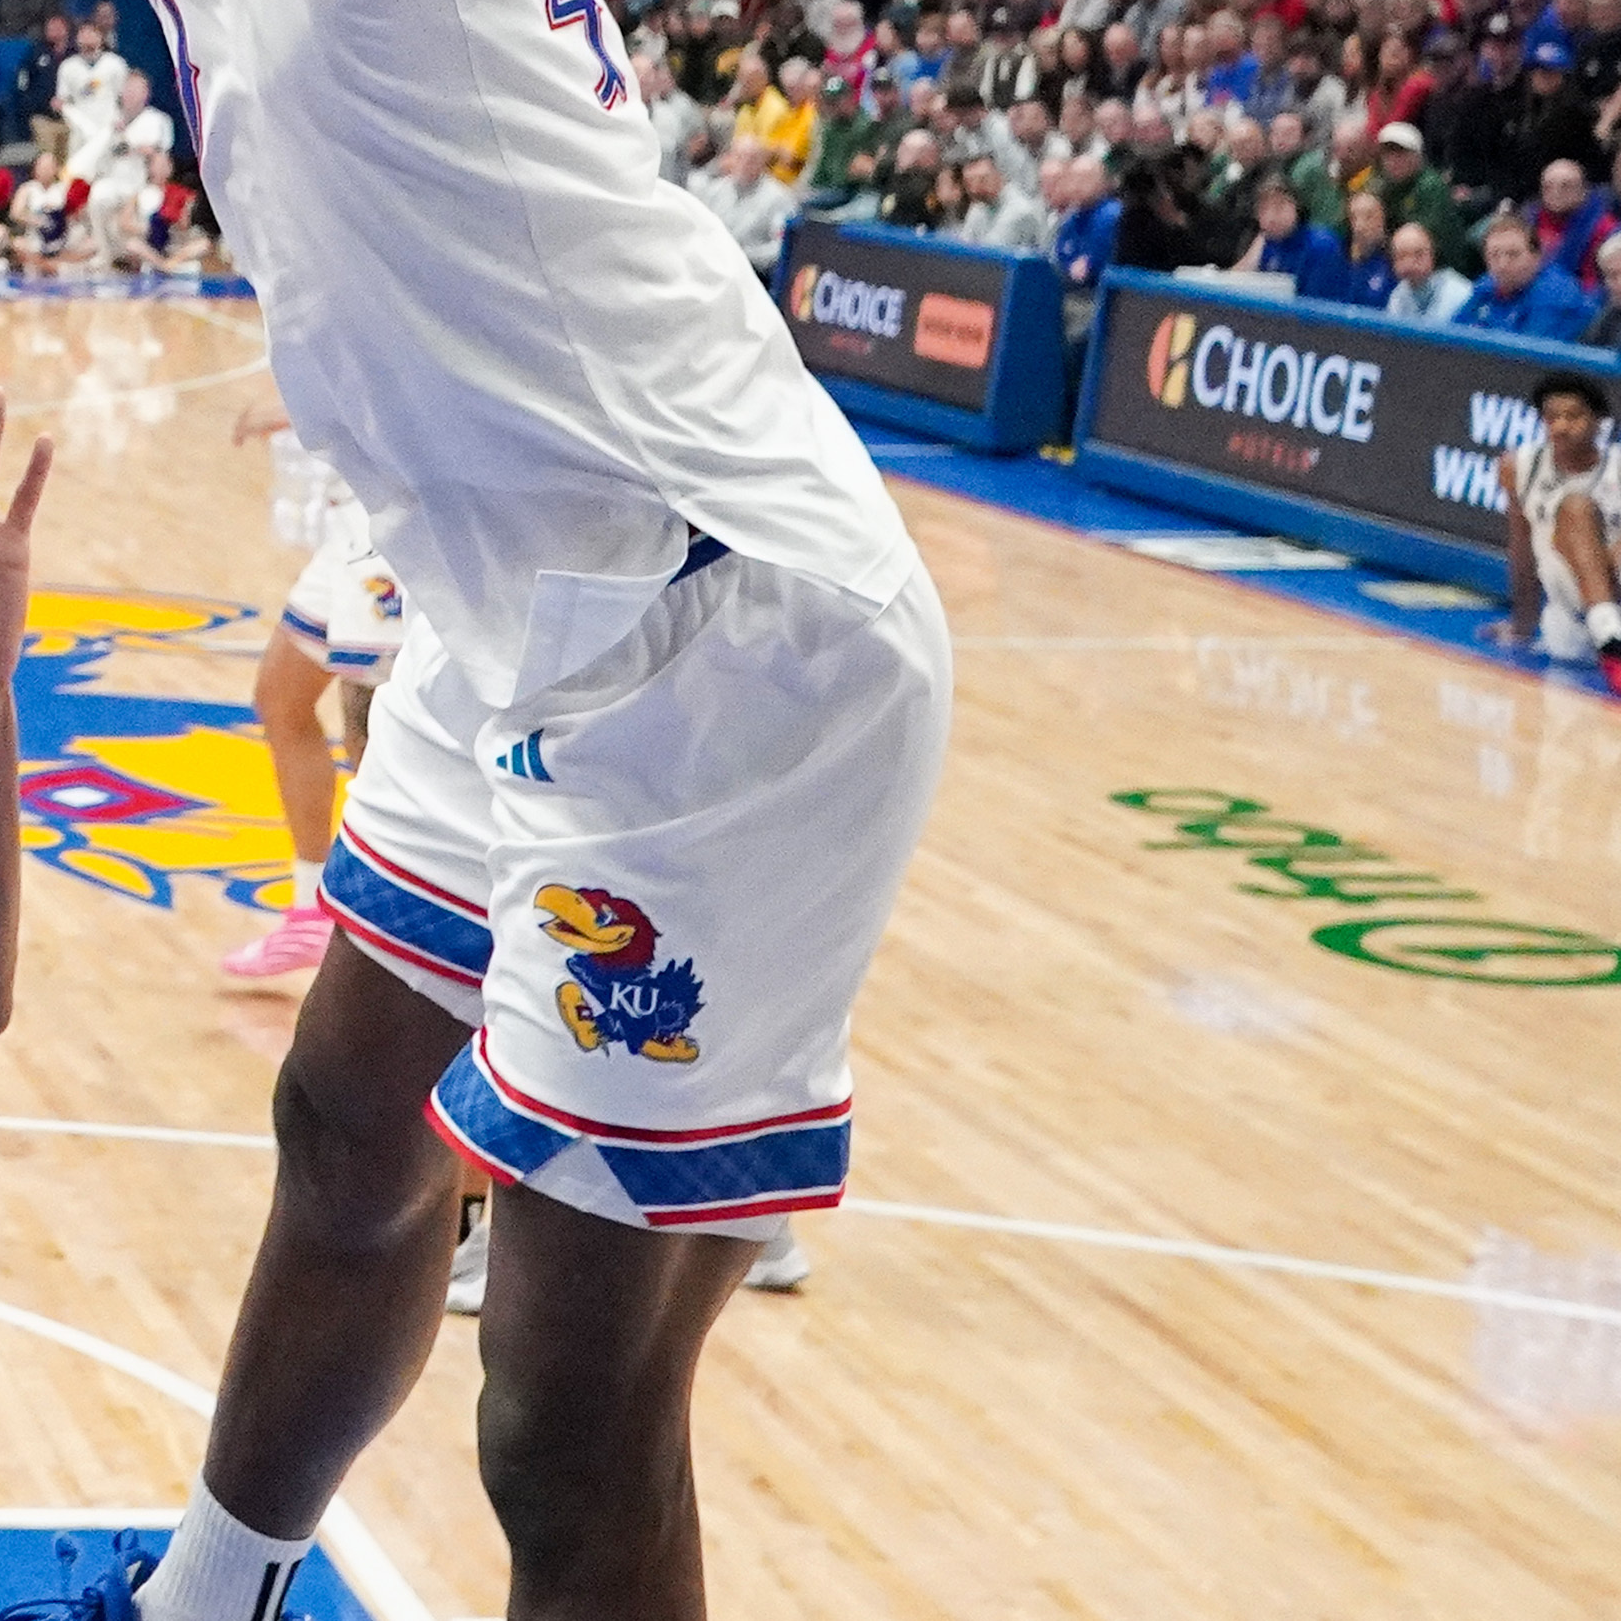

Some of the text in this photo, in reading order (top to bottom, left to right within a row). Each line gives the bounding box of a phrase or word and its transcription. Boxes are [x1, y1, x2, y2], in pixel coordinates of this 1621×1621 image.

[814, 269, 907, 339] CHOICE
[1192, 324, 1382, 443] CHOICE
[610, 981, 659, 1017] KU
